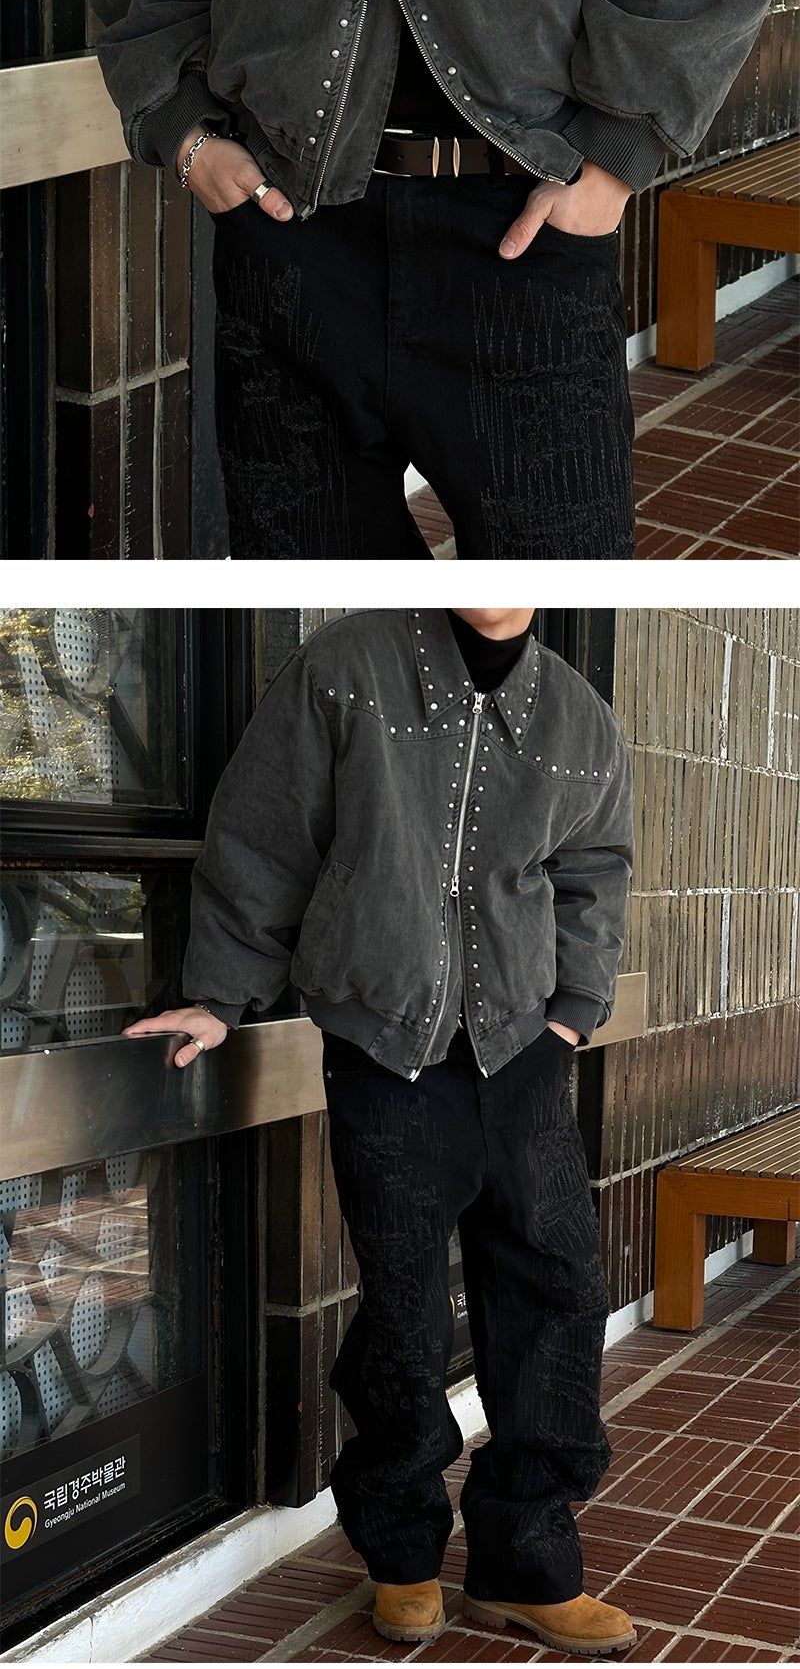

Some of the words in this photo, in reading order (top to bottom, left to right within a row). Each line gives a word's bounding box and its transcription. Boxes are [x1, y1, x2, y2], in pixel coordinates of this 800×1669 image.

[44, 1456, 126, 1510] 국립경주박물관
[44, 1508, 75, 1528] Gyeongju
[75, 1493, 101, 1513] National
[101, 1482, 126, 1500] Museum
